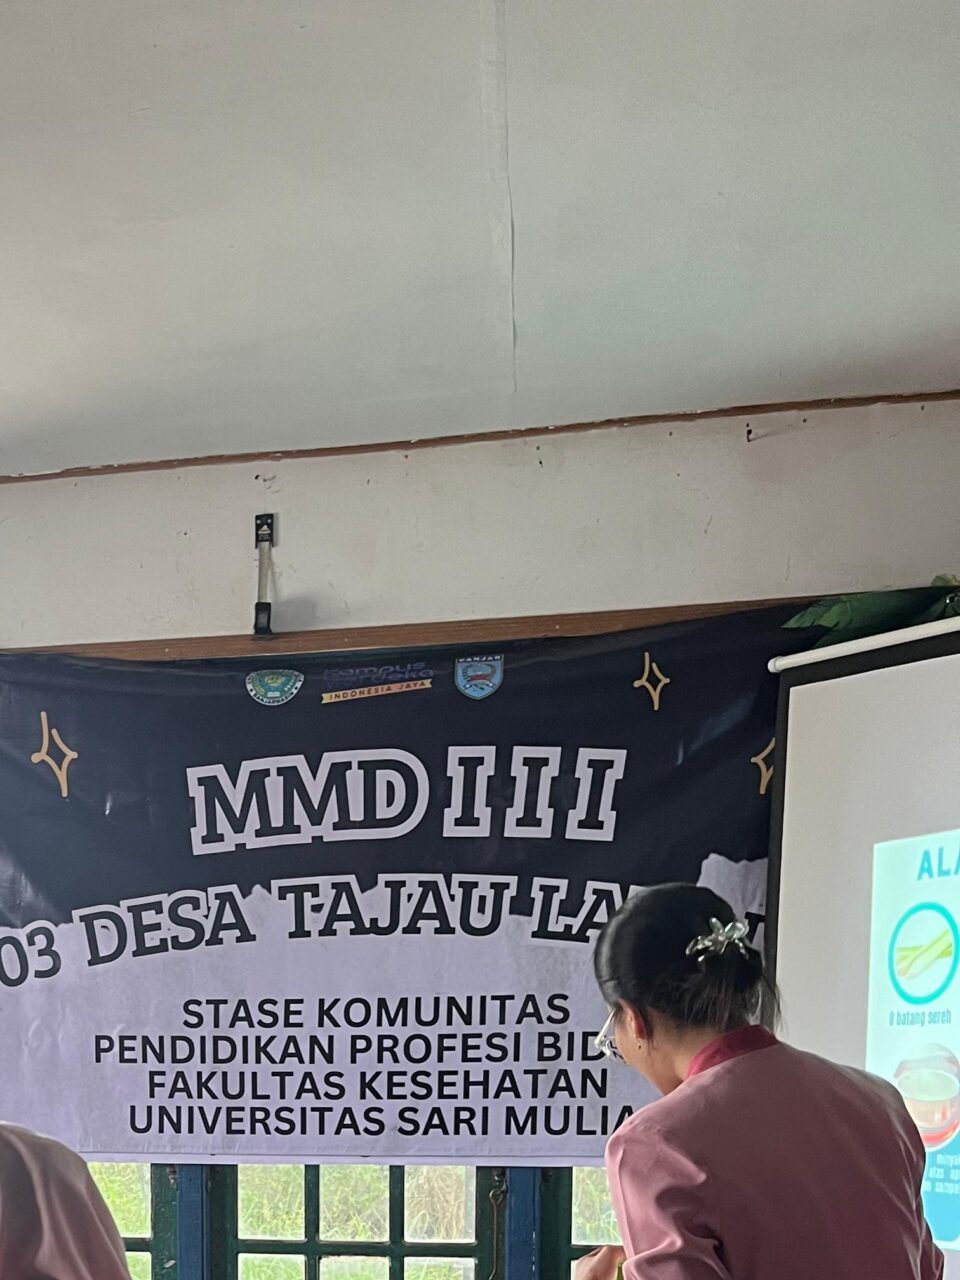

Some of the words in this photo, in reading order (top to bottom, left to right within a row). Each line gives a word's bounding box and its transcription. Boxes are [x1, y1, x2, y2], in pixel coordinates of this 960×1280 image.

[329, 685, 392, 700] INDONESIA
[399, 681, 426, 691] JAYA
[187, 749, 429, 855] MMD
[79, 890, 257, 966] DESA
[277, 879, 511, 938] TAJAU
[182, 999, 305, 1029] STASE
[317, 993, 570, 1028] KOMUNITAS
[928, 1008, 952, 1025] sereh
[94, 1034, 335, 1064] PENDIDIKAN
[350, 1032, 521, 1064] PROFESI
[536, 1031, 608, 1062] BID
[148, 1070, 346, 1100] FAKULTAS
[359, 1068, 608, 1100] KESEHATAN
[129, 1104, 386, 1136] UNIVERSITAS
[397, 1105, 489, 1136] SARI
